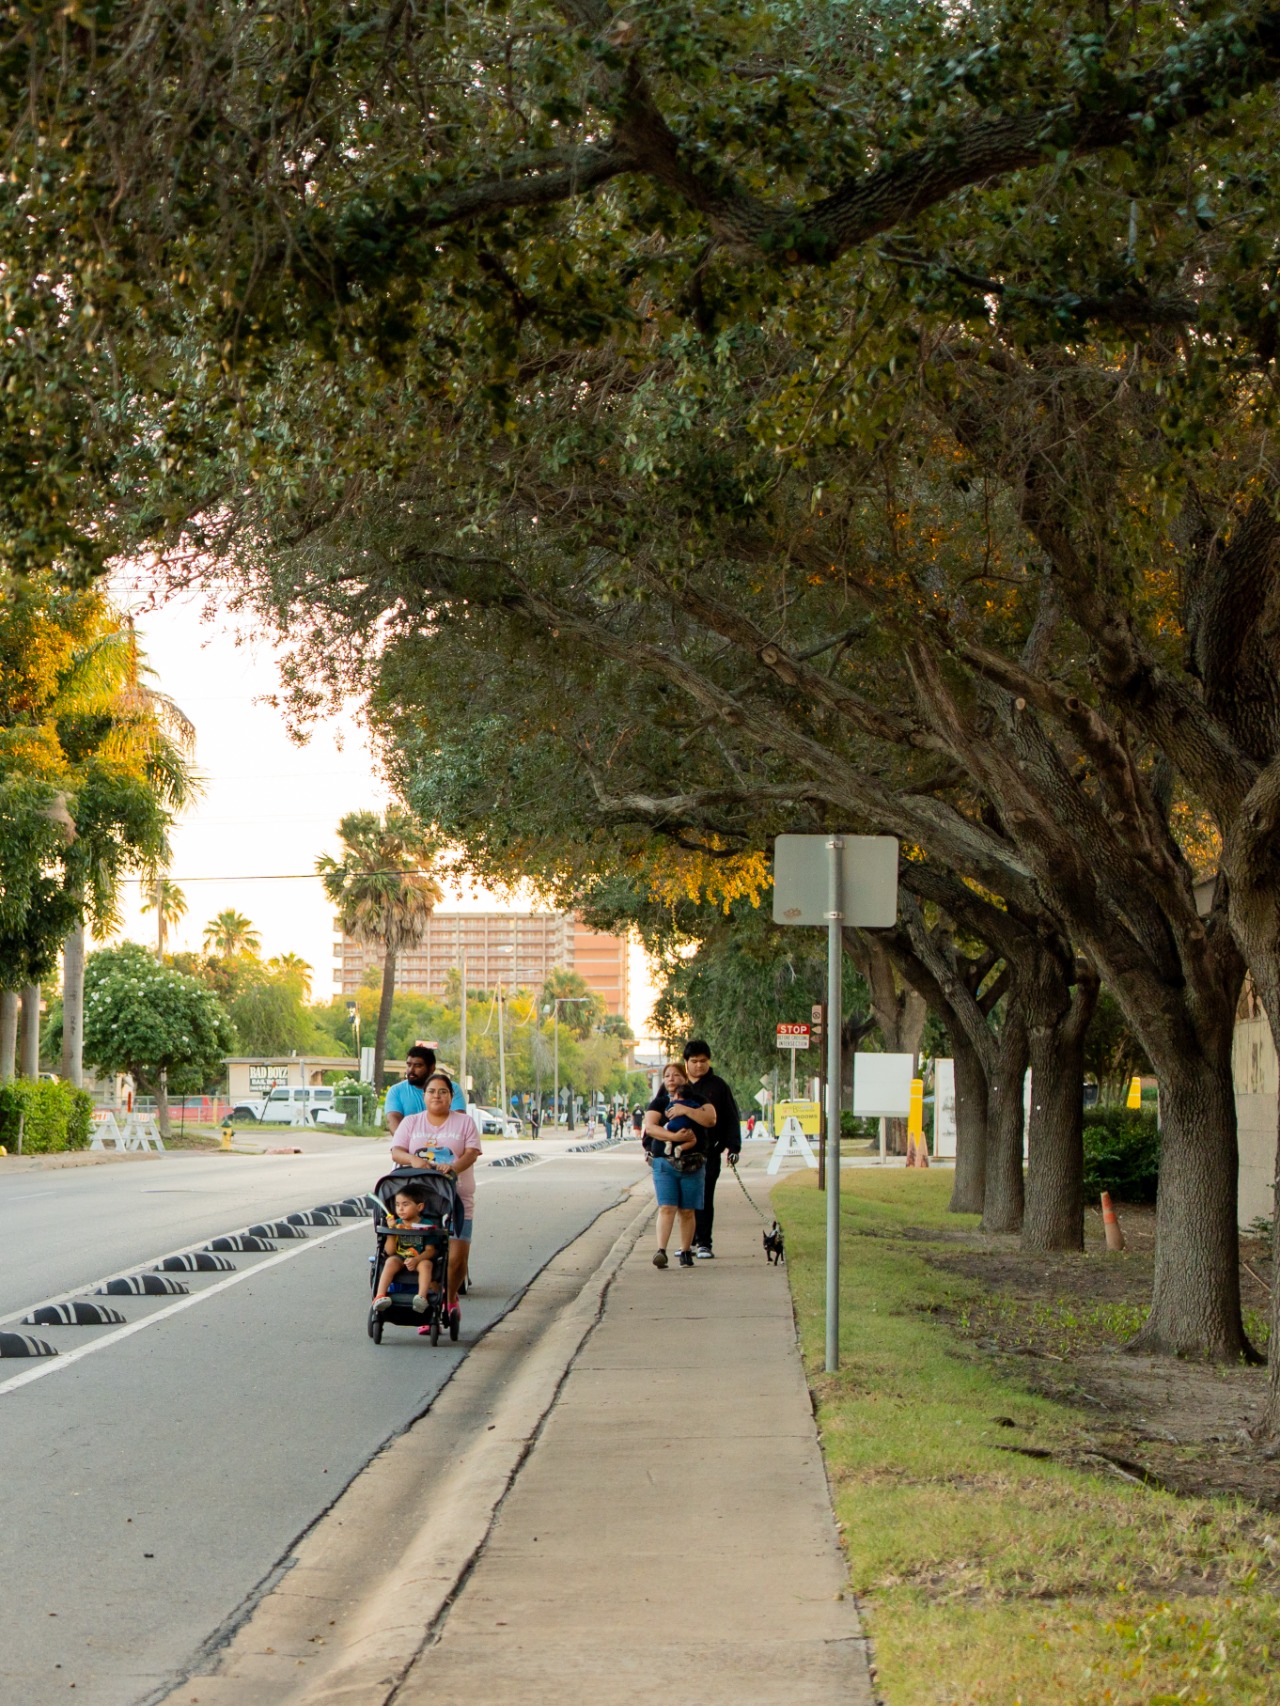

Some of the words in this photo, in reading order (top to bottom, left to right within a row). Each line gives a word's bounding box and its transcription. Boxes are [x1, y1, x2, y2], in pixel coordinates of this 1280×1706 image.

[780, 1025, 808, 1034] STOP
[250, 1066, 267, 1079] BAD
[267, 1066, 288, 1079] BOYZ
